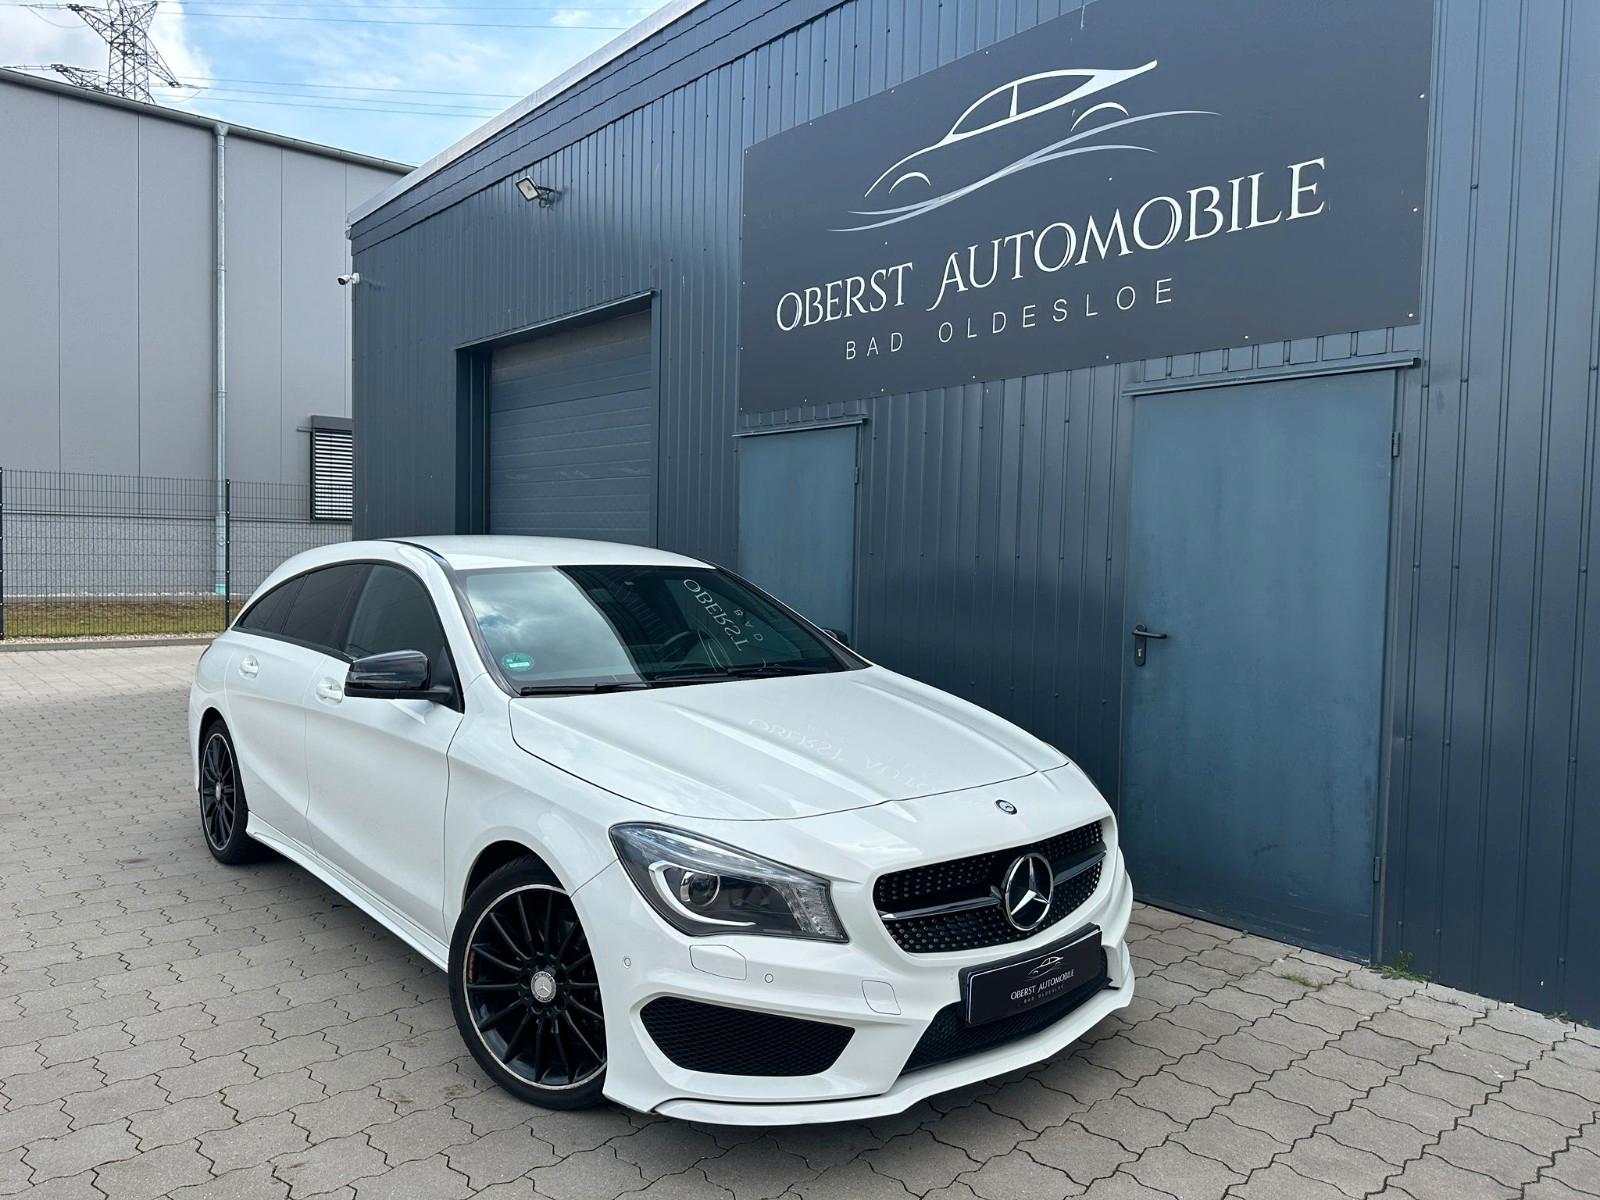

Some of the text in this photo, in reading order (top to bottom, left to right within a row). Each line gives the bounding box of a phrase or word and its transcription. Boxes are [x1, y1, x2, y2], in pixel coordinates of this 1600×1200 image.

[776, 157, 1326, 332] OBERST AUTOMOBILE
[846, 277, 1172, 360] BAD OLDESLOE
[1010, 984, 1037, 1000] OBERST
[1037, 968, 1074, 993] AUTOMOBILE
